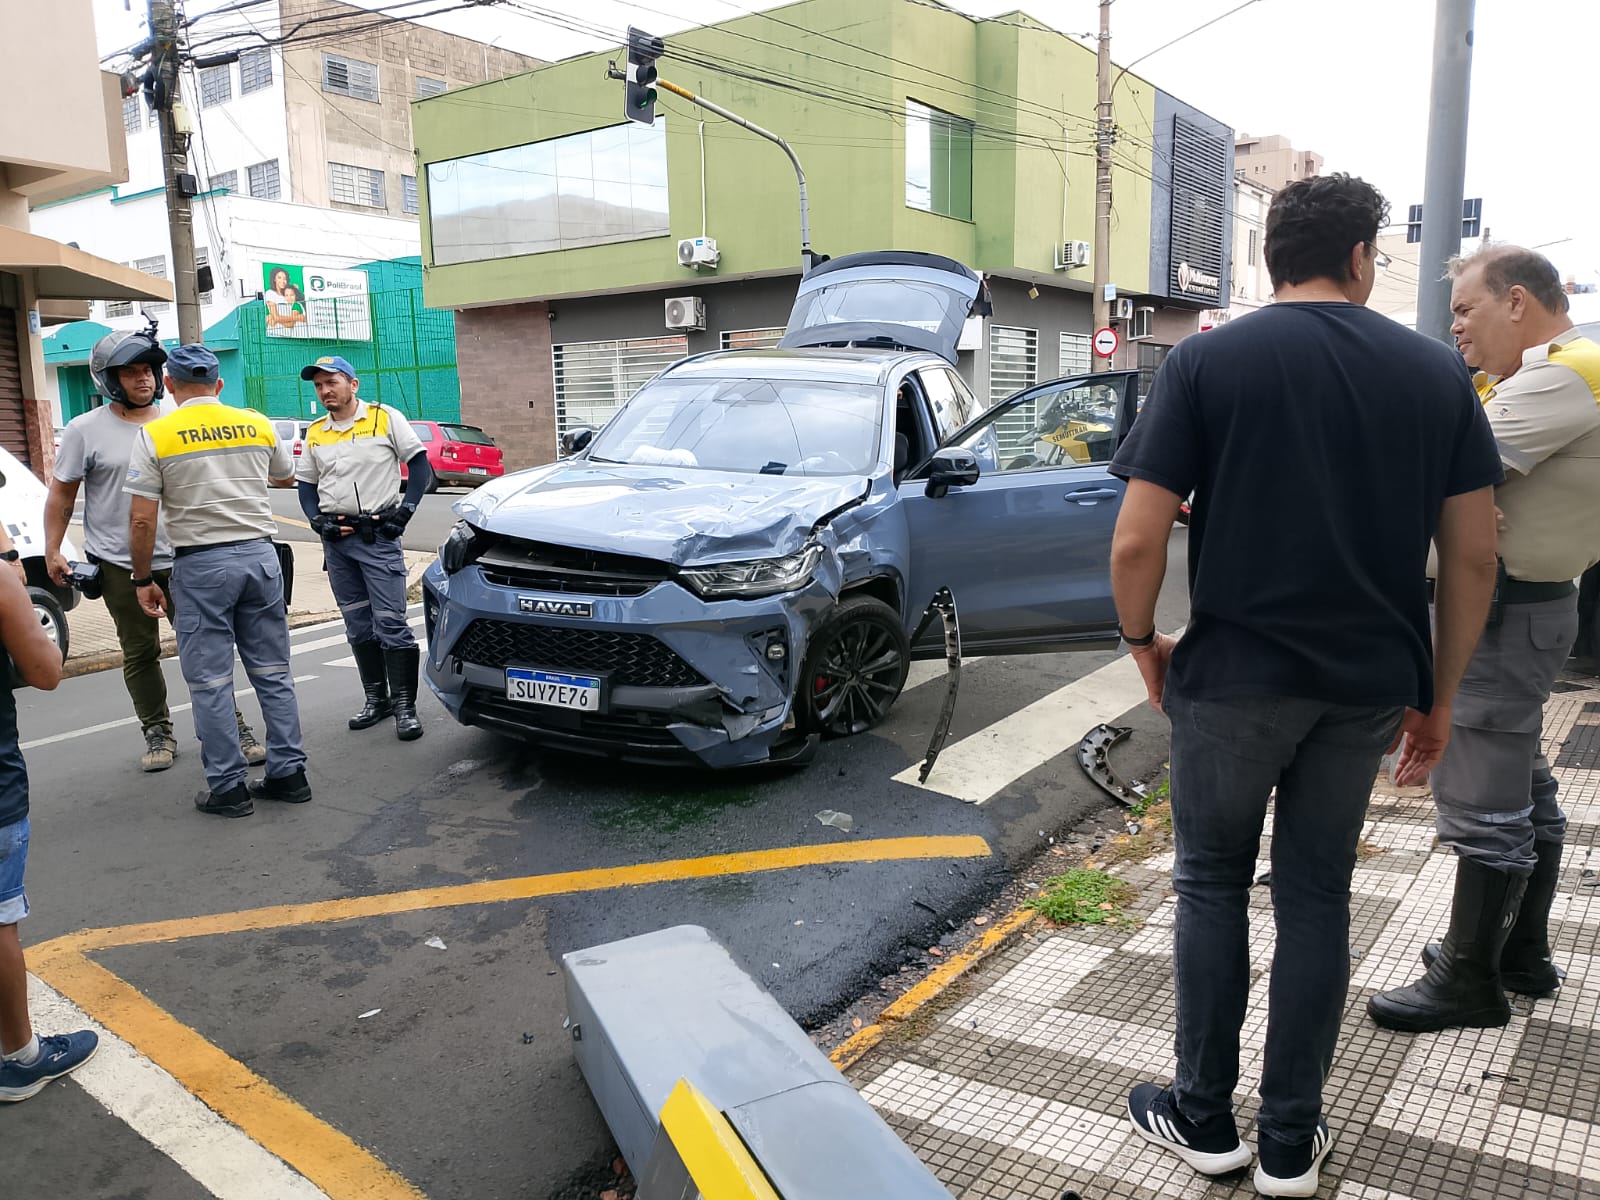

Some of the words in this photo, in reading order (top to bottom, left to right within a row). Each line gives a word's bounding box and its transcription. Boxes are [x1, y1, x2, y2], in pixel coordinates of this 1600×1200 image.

[177, 424, 257, 445] TRÂNSITO
[1052, 424, 1088, 442] SEMUTTRAN
[520, 599, 589, 616] HAVAL
[516, 681, 588, 707] SUY7E76
